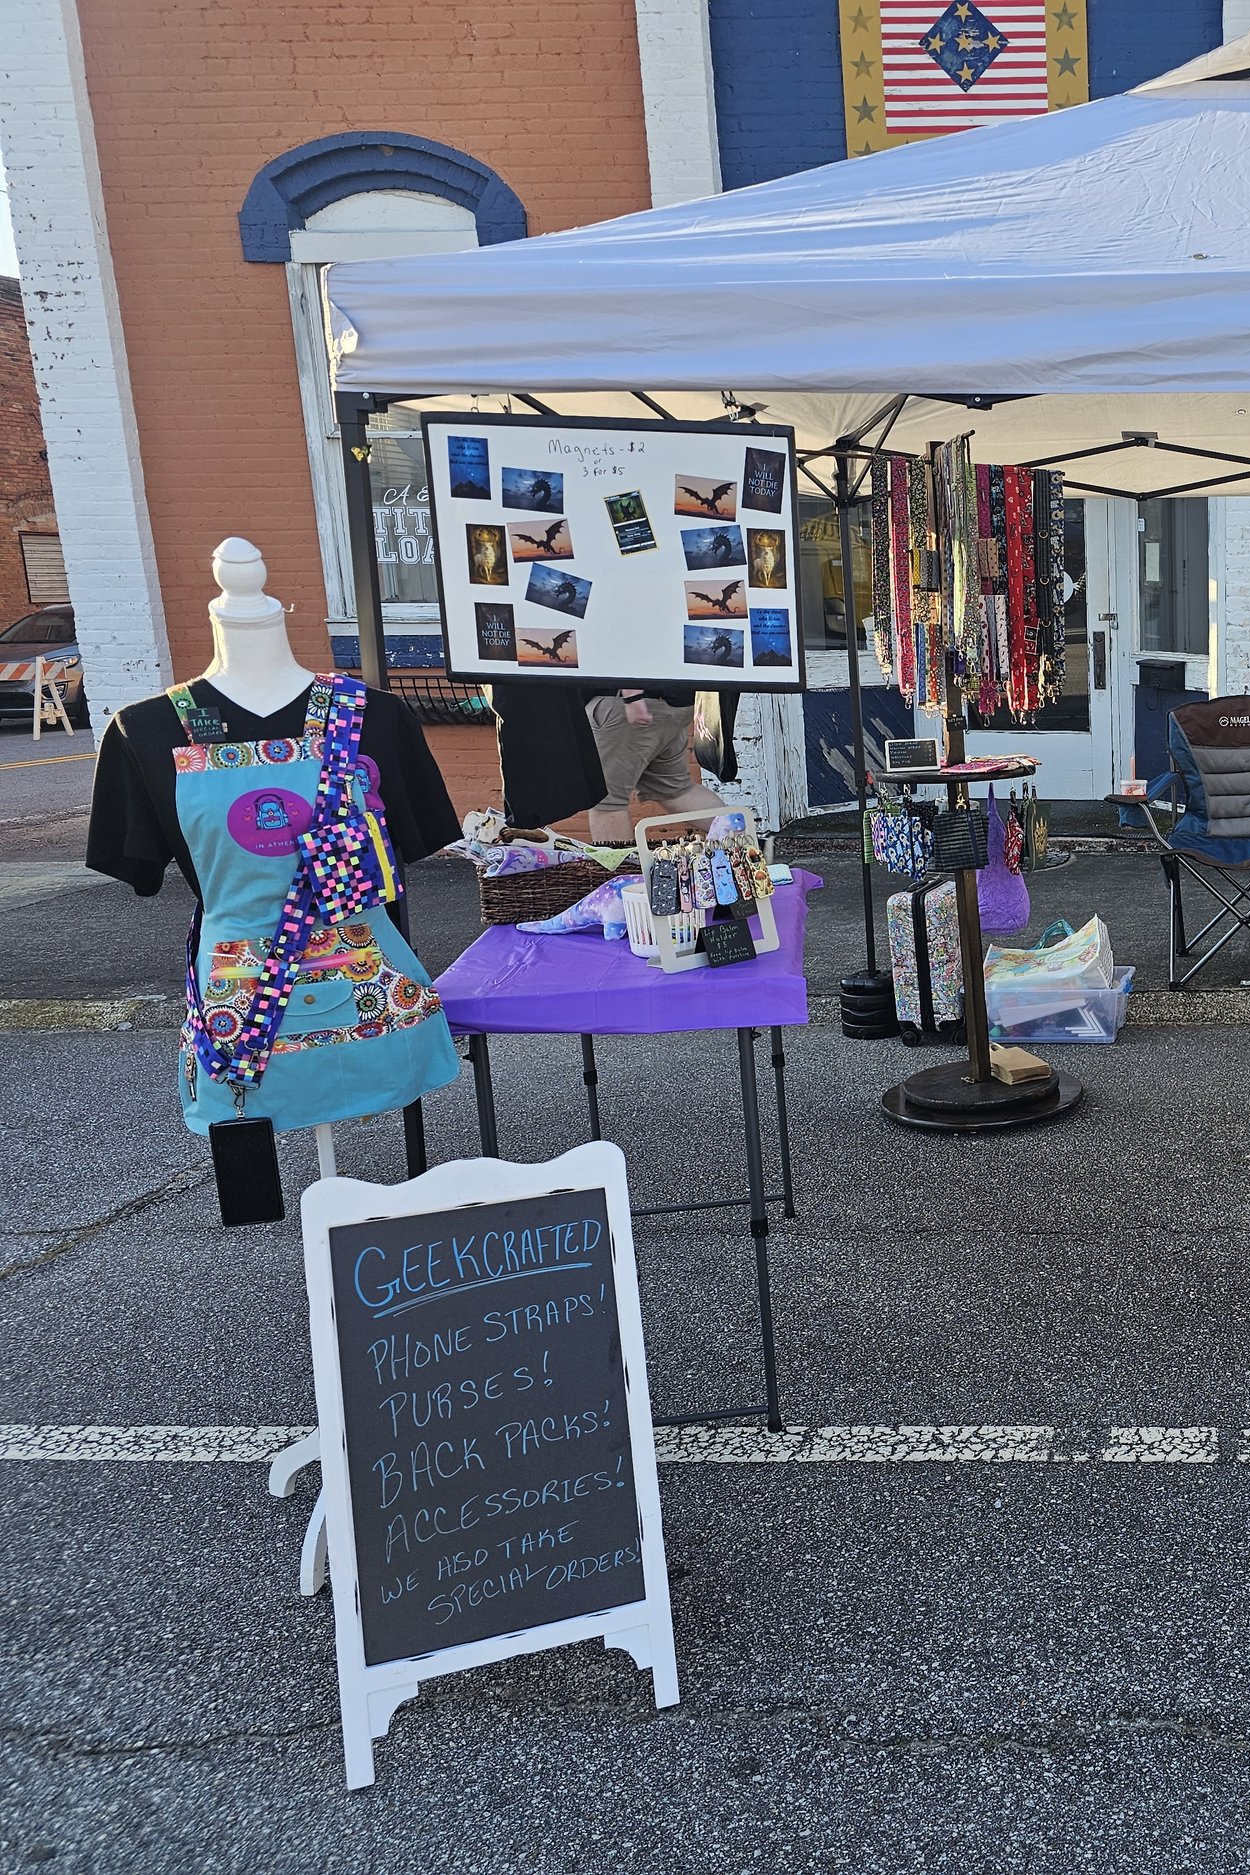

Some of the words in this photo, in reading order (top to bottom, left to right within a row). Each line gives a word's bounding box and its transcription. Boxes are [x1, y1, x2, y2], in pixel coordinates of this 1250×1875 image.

[549, 439, 615, 462] Magnets
[583, 467, 588, 477] 3
[612, 465, 626, 476] $5
[754, 470, 774, 481] WILL
[748, 477, 766, 488] NOT
[766, 480, 779, 490] DIE
[750, 485, 776, 497] TODAY
[486, 622, 505, 631] WILL
[482, 630, 499, 638] NOT
[499, 630, 511, 639] DIE
[483, 637, 510, 646] TODAY
[196, 707, 210, 717] I
[190, 719, 220, 727] TAKE
[268, 840, 299, 849] ATHEN
[366, 1324, 473, 1386] PHONE
[482, 1282, 607, 1343] STRAPS!
[378, 1350, 554, 1438] PURSES!
[372, 1438, 486, 1509] BACK
[495, 1399, 612, 1459] PACKS!
[385, 1456, 625, 1564] ACCESSORIES!
[380, 1574, 419, 1605] WE
[497, 1520, 580, 1560] TAKE
[427, 1564, 549, 1626] SPECIAL
[545, 1537, 642, 1591] ORDERS!
